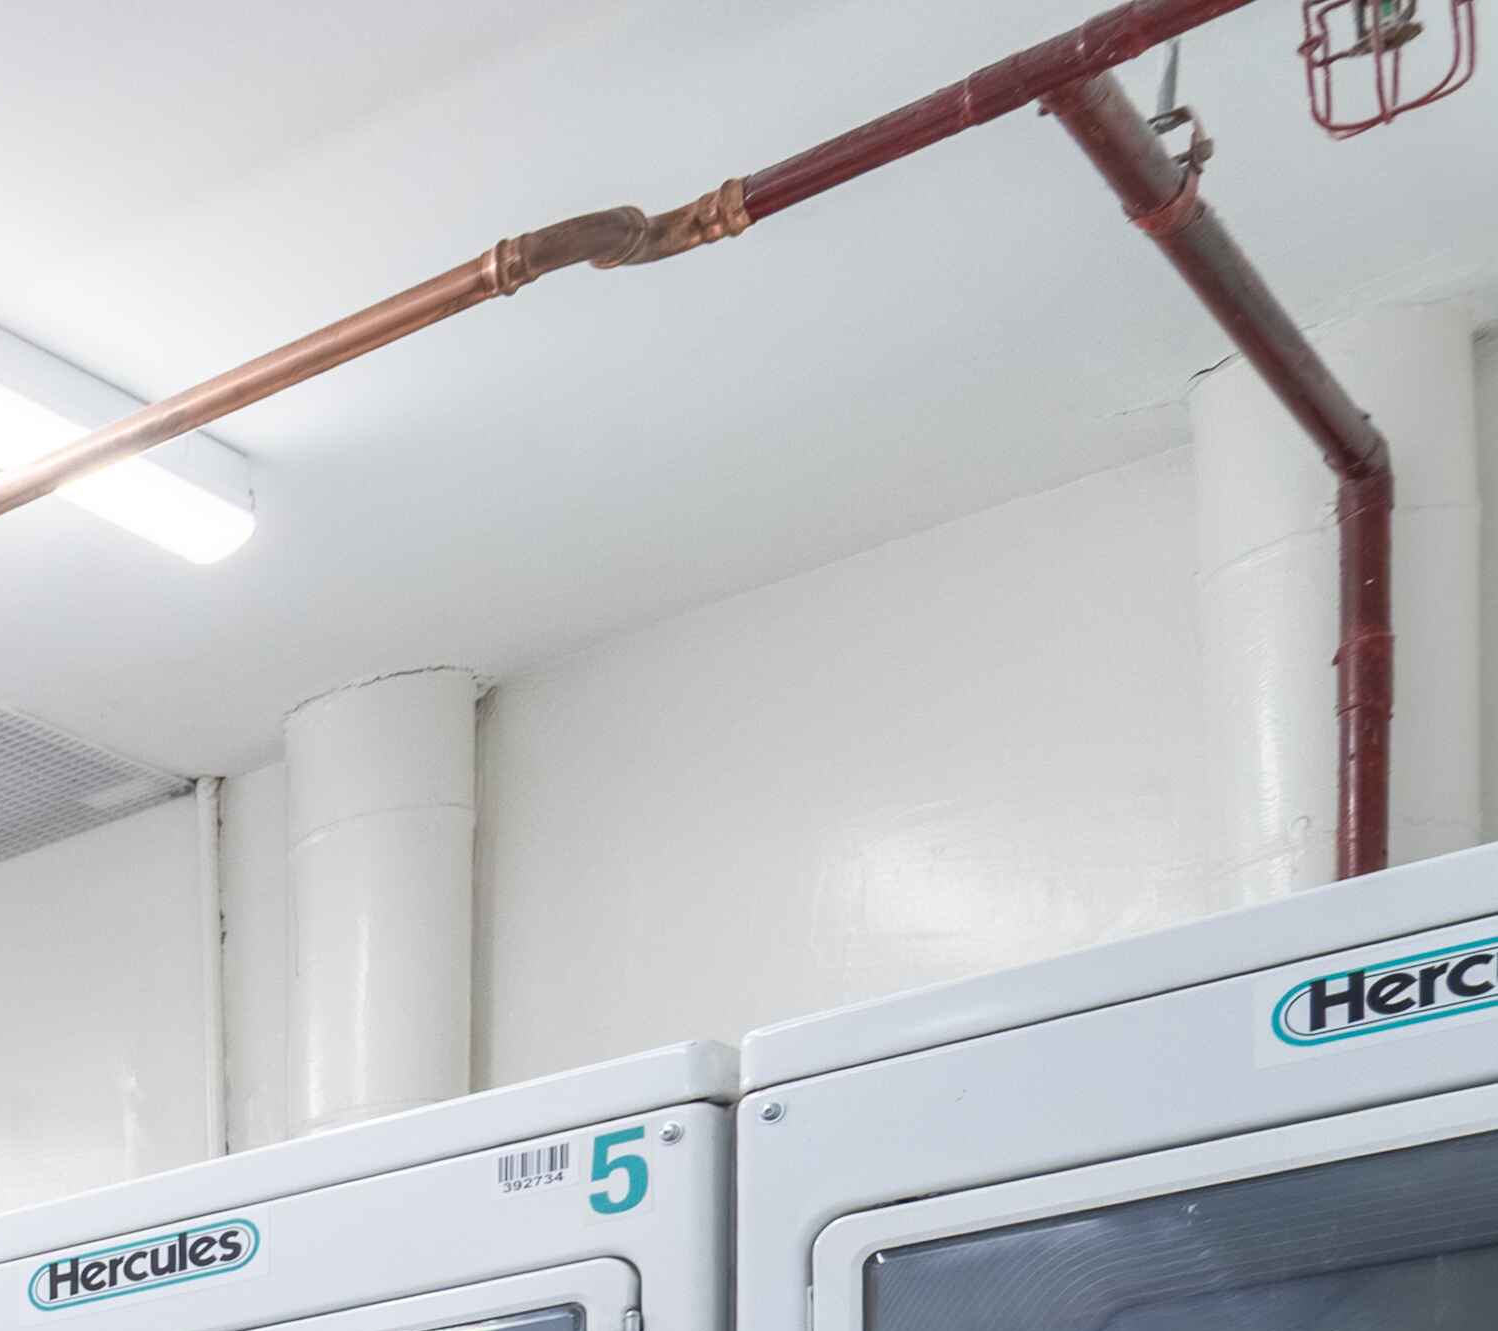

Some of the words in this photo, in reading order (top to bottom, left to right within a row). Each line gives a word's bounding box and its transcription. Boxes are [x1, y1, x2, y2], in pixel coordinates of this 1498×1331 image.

[1310, 952, 1498, 1032] Herc
[503, 1172, 565, 1194] 392734
[588, 1125, 649, 1216] 5
[48, 1229, 242, 1302] Hercules
